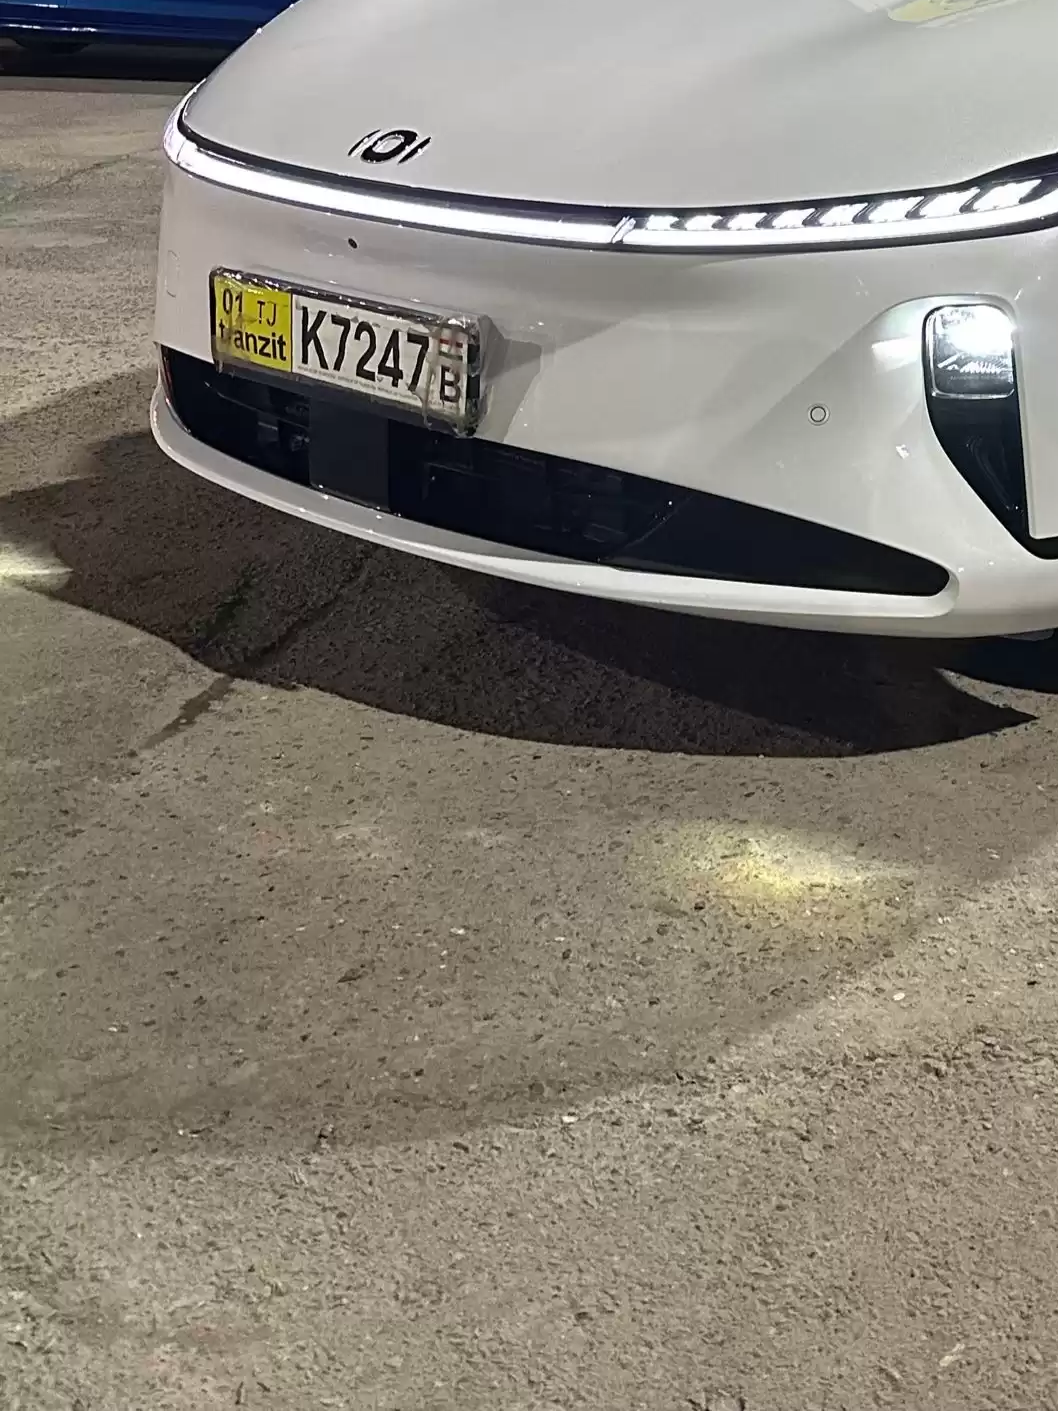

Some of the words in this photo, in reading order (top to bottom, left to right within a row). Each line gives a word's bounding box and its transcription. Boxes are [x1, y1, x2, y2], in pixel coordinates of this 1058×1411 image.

[222, 288, 243, 316] 01
[257, 300, 277, 327] TJ
[218, 318, 287, 362] tanzit
[300, 305, 430, 393] K7247
[439, 364, 462, 404] B
